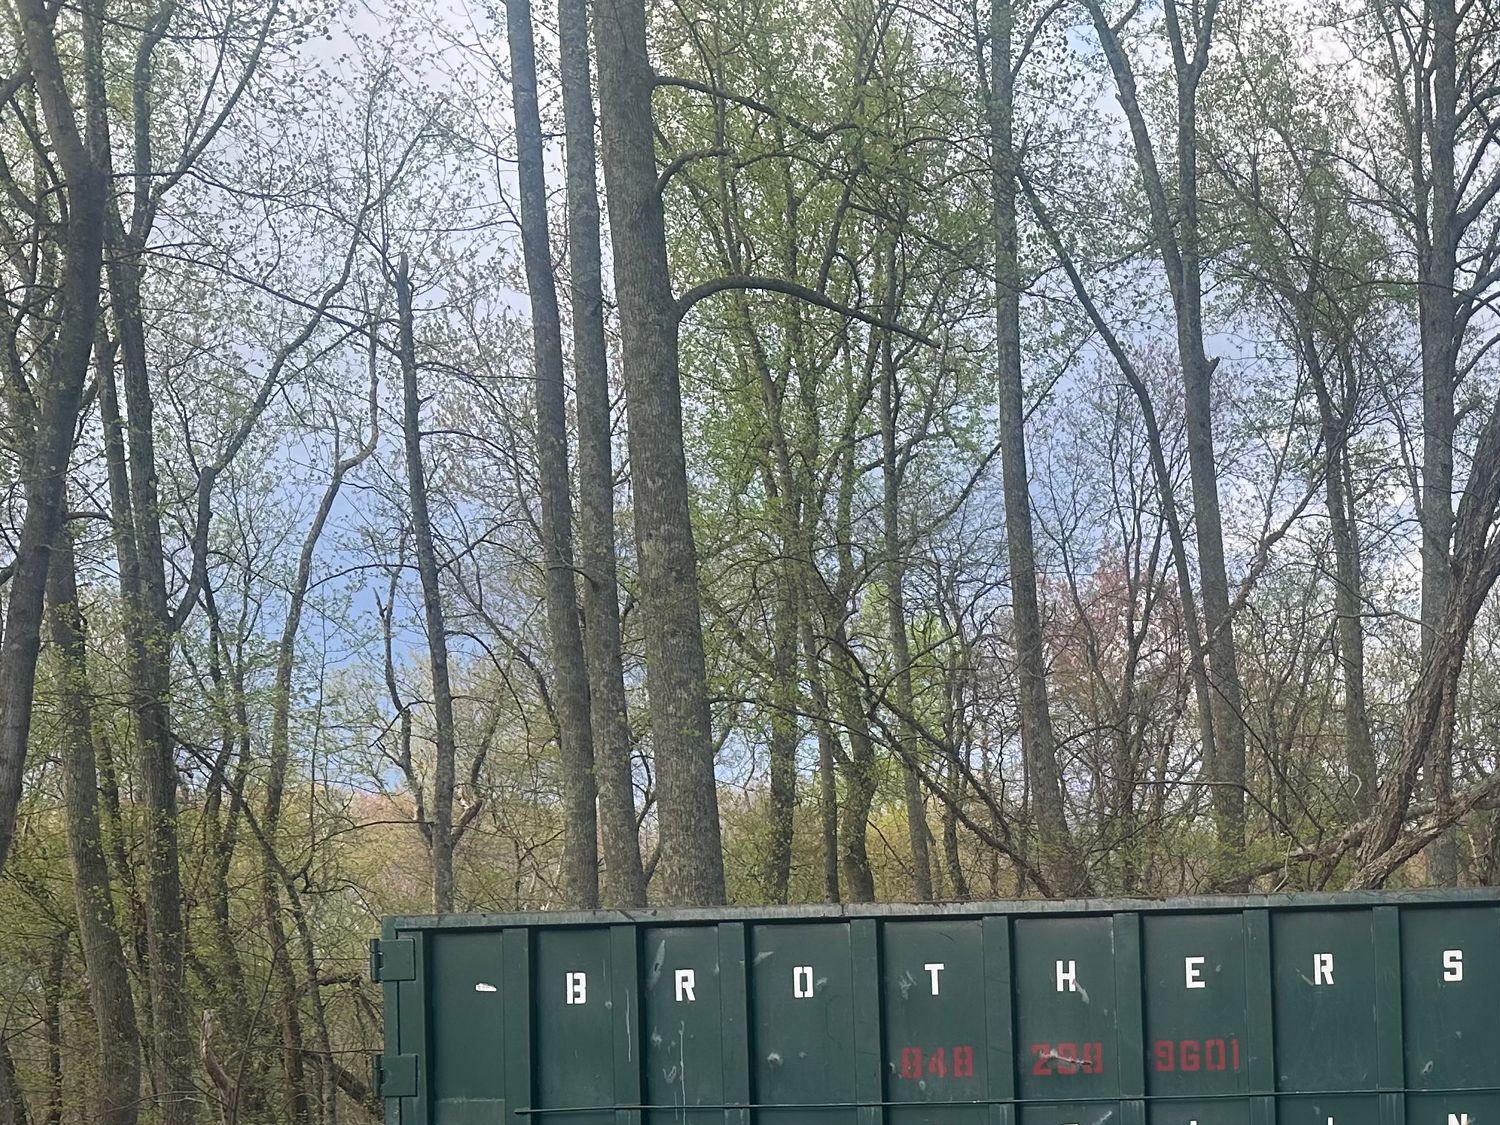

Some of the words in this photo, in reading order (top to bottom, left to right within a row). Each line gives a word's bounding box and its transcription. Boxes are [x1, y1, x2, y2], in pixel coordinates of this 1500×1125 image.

[566, 949, 1464, 1006] BROTHERS
[901, 1045, 975, 1079] 848
[1031, 1042, 1105, 1076] 298
[1153, 1039, 1240, 1073] 9601
